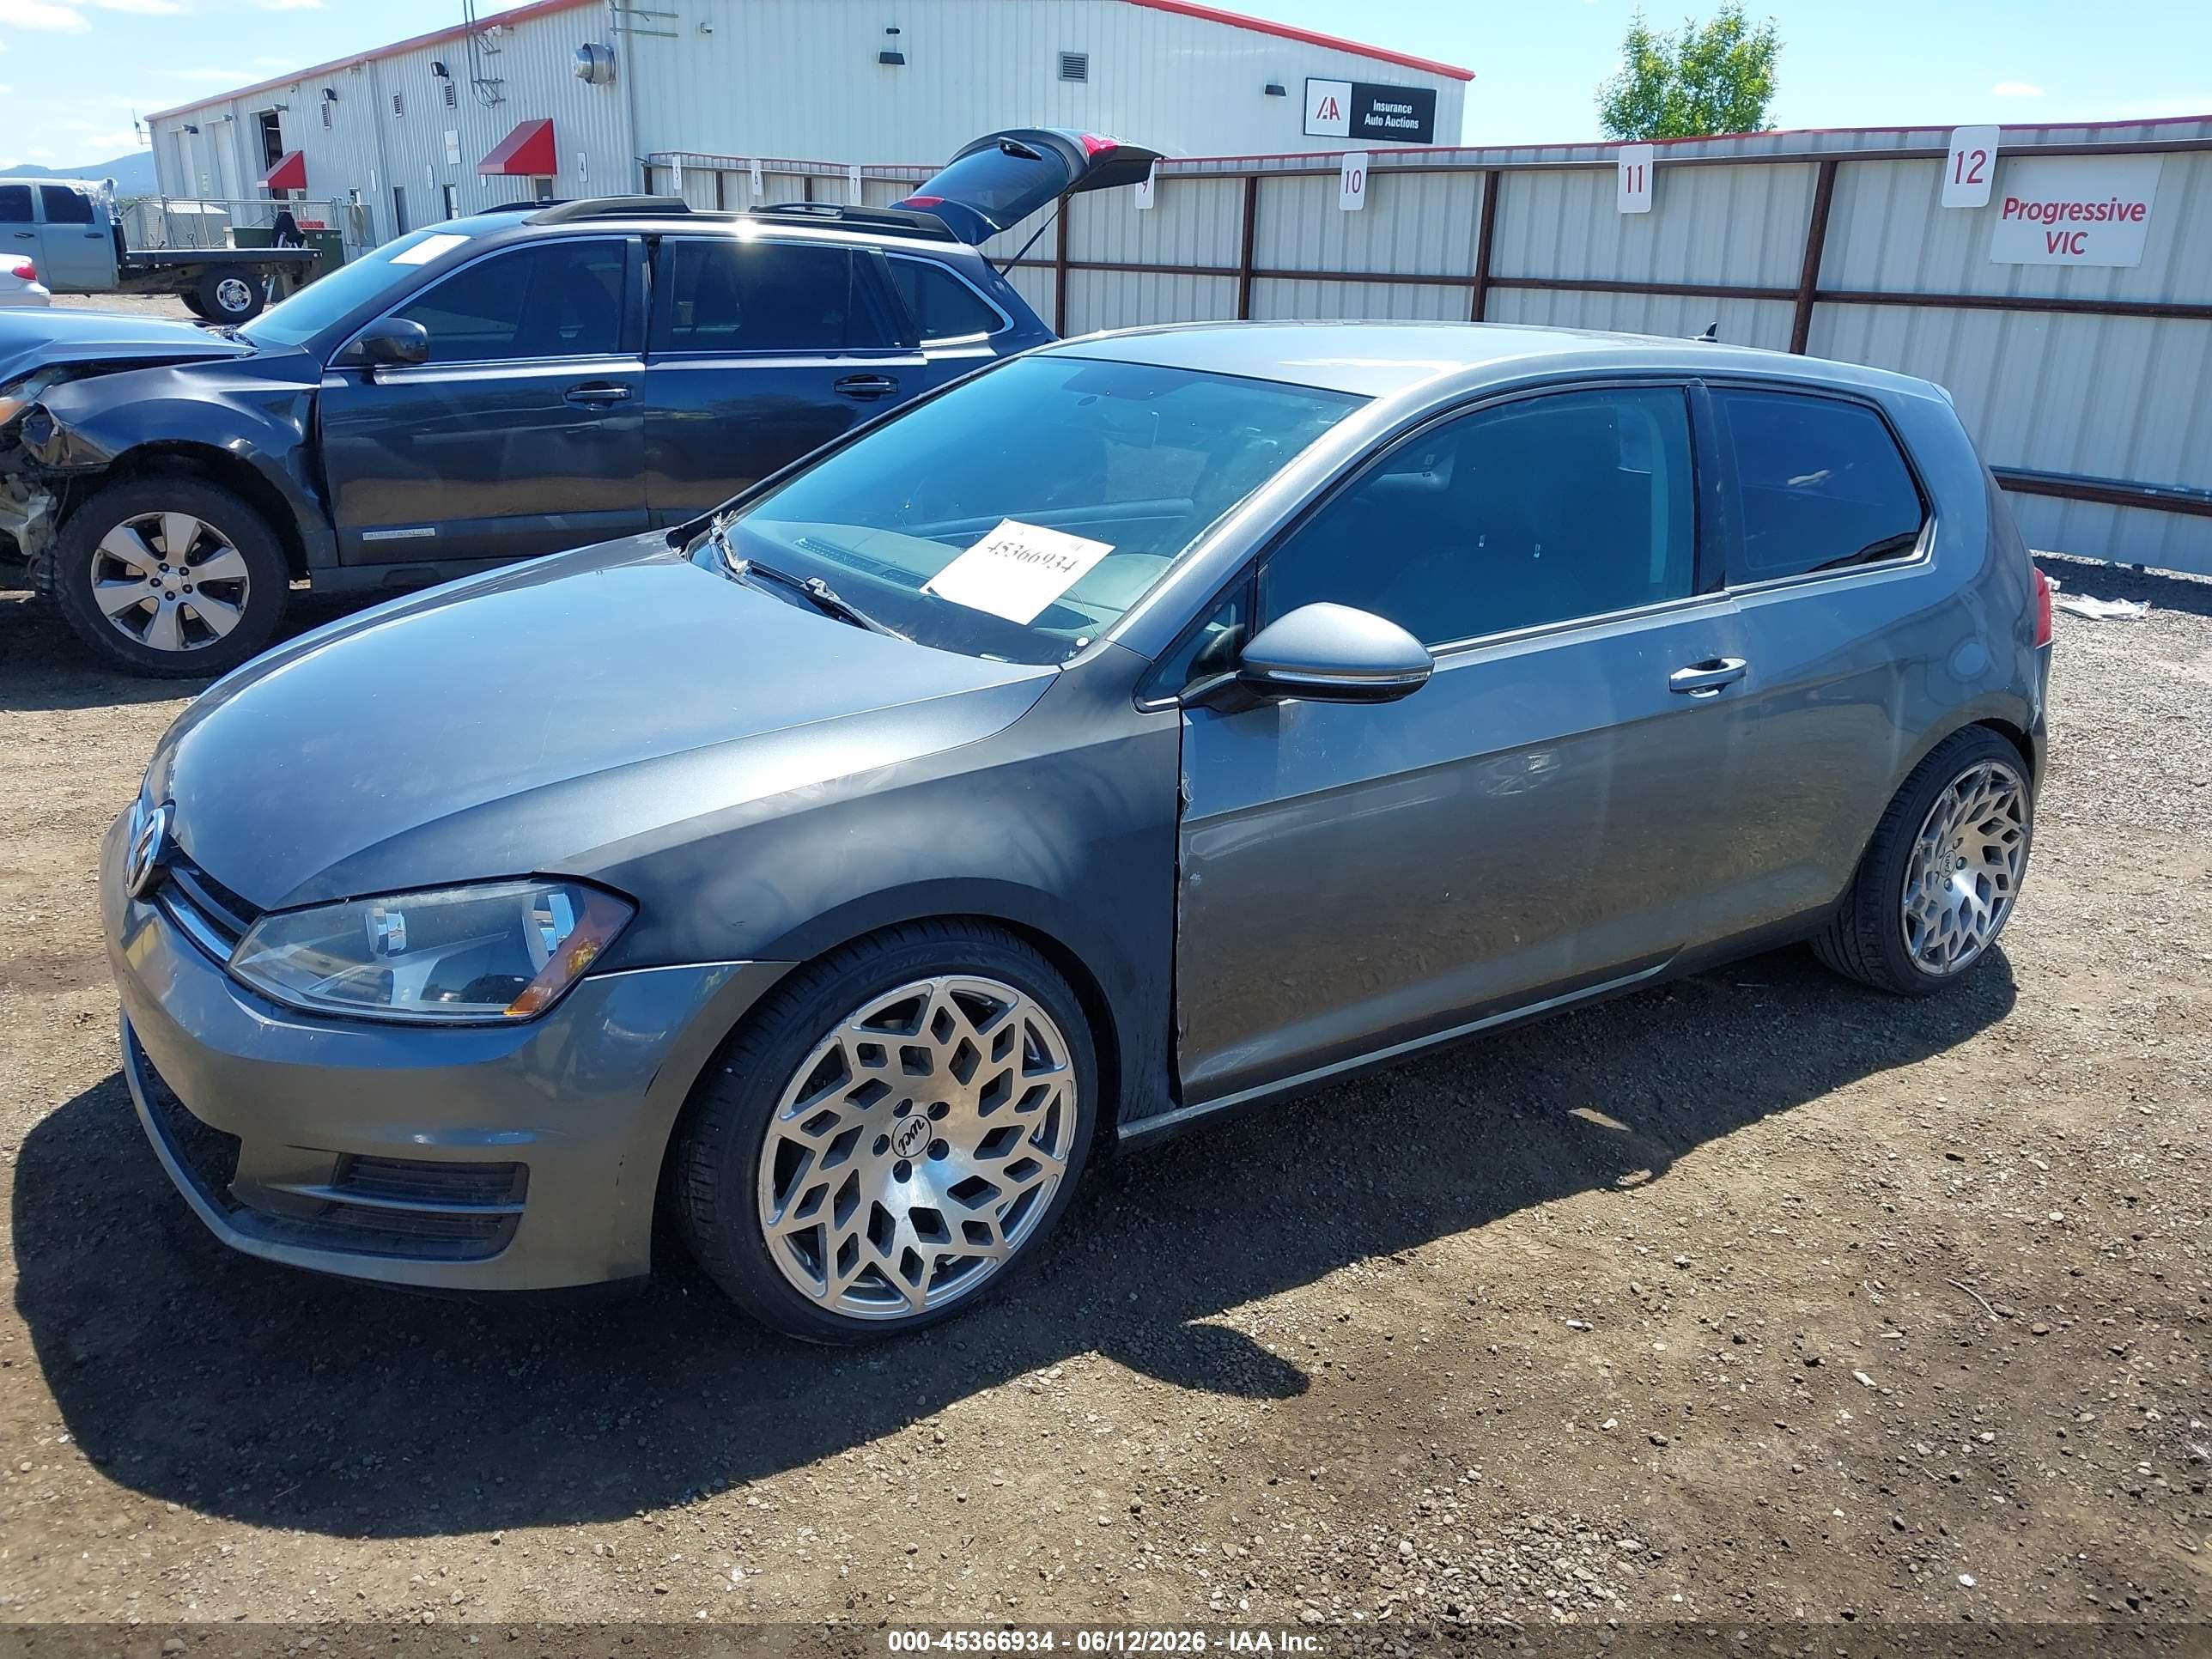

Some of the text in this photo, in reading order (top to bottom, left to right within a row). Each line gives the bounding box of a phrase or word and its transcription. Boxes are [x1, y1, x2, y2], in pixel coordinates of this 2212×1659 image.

[1373, 99, 1413, 114] Insurance
[1364, 112, 1419, 129] Auto Auctions
[754, 170, 759, 185] 6
[1626, 164, 1643, 194] 11
[1954, 149, 1987, 185] 12
[853, 177, 858, 195] 7
[1345, 169, 1362, 194] 10
[2002, 198, 2146, 225] Progressive
[2046, 231, 2088, 255] VIC
[988, 540, 1079, 573] 45366934
